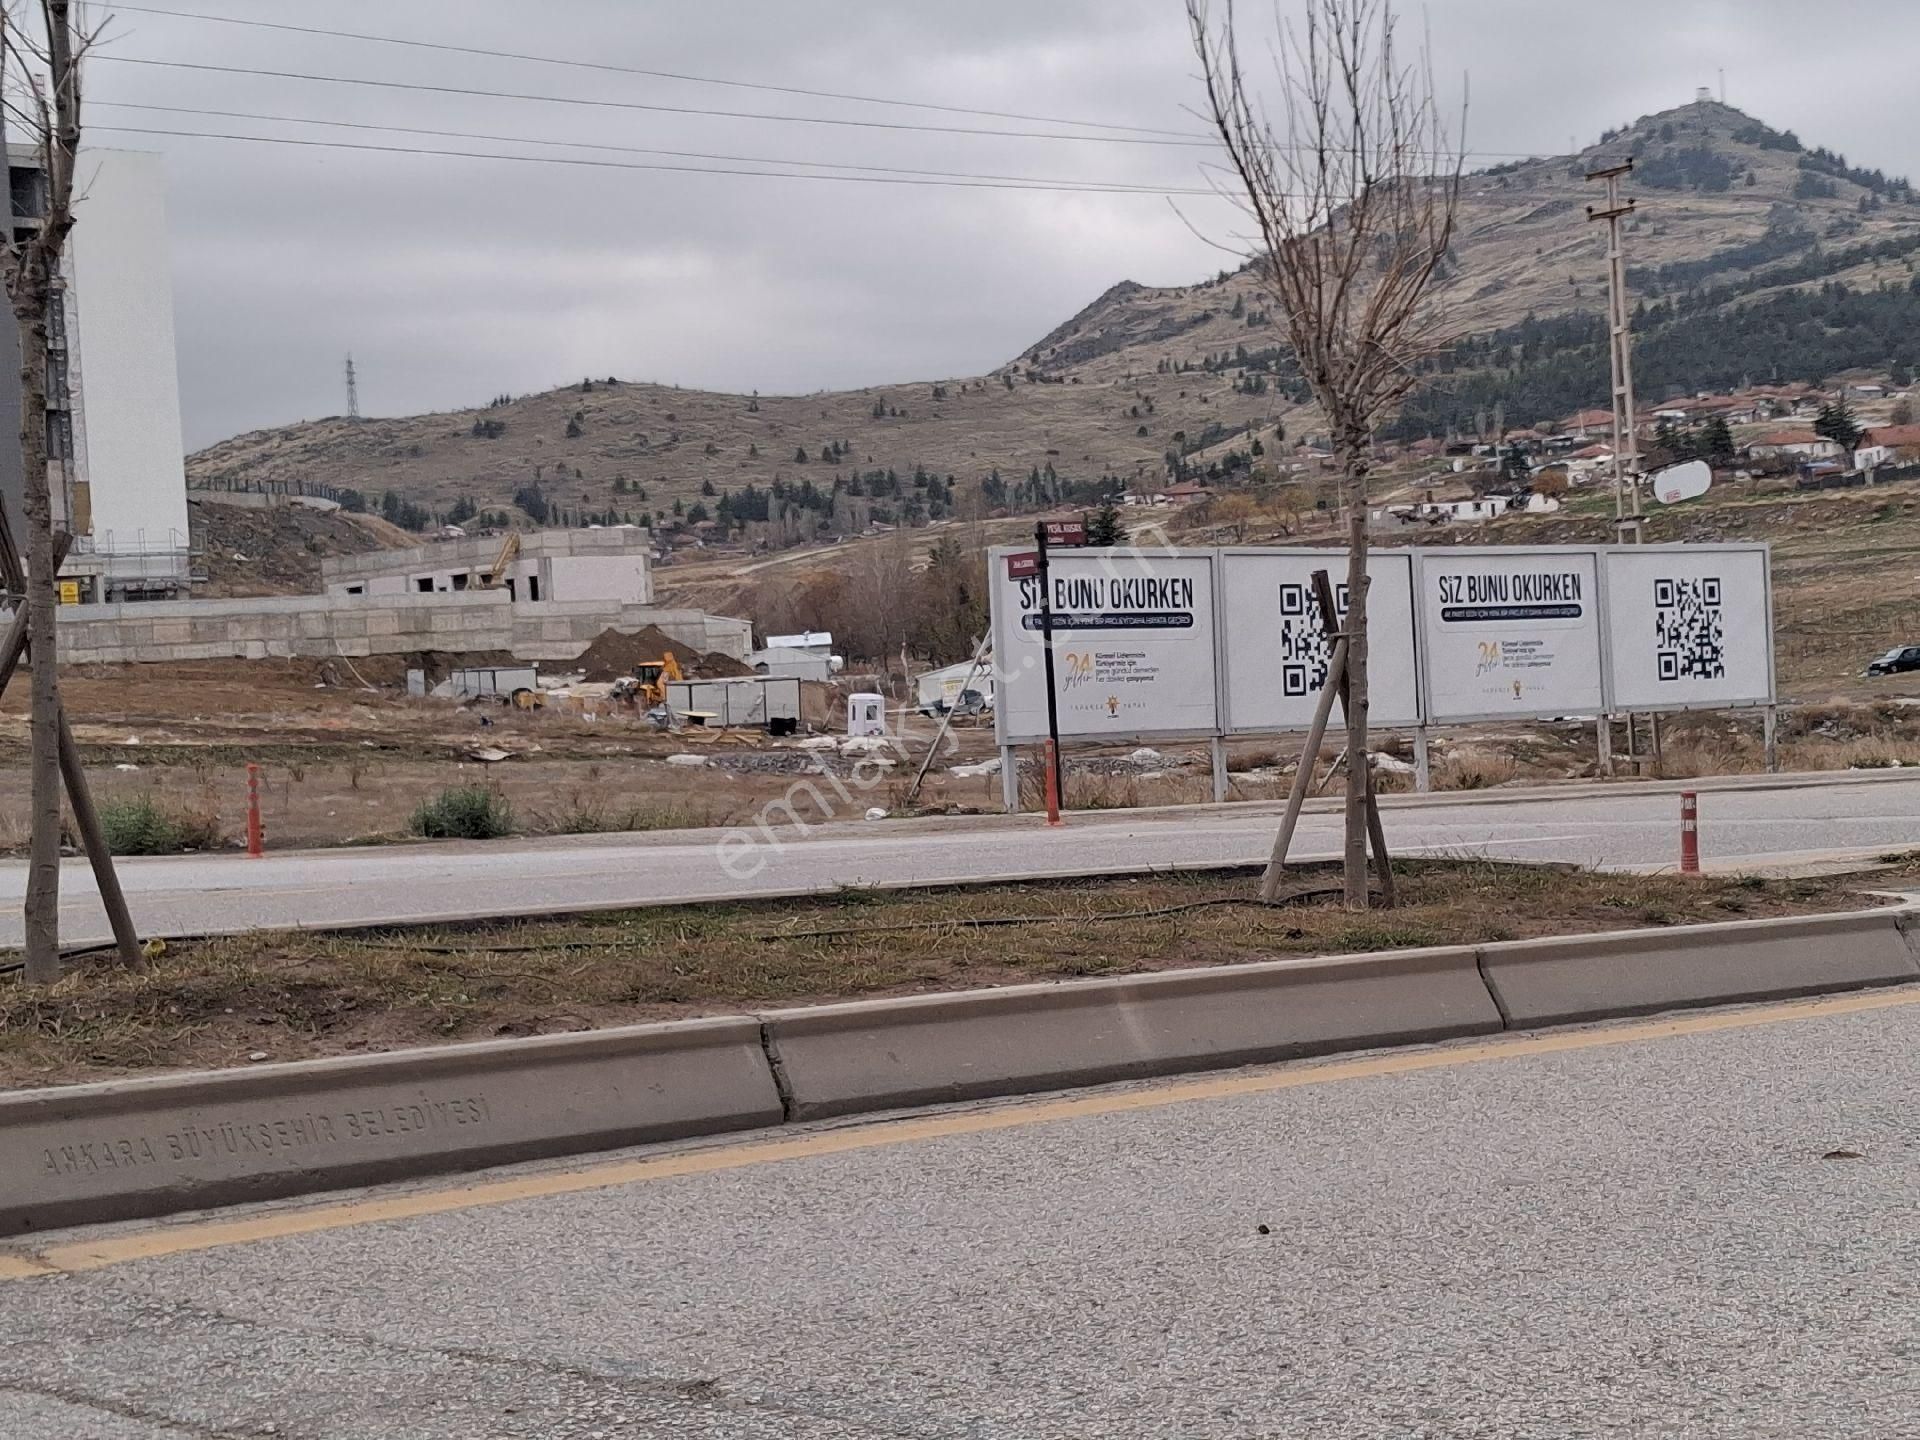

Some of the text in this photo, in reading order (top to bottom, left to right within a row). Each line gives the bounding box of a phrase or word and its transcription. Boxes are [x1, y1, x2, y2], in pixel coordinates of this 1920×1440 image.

[1055, 578, 1104, 610] BUNU
[1110, 577, 1194, 609] OKURKEN
[1439, 573, 1582, 604] SİZ BUNU OKURKEN
[42, 1092, 494, 1178] ANKARA BÜYÜKŞEHİR BELEDİYESİ
